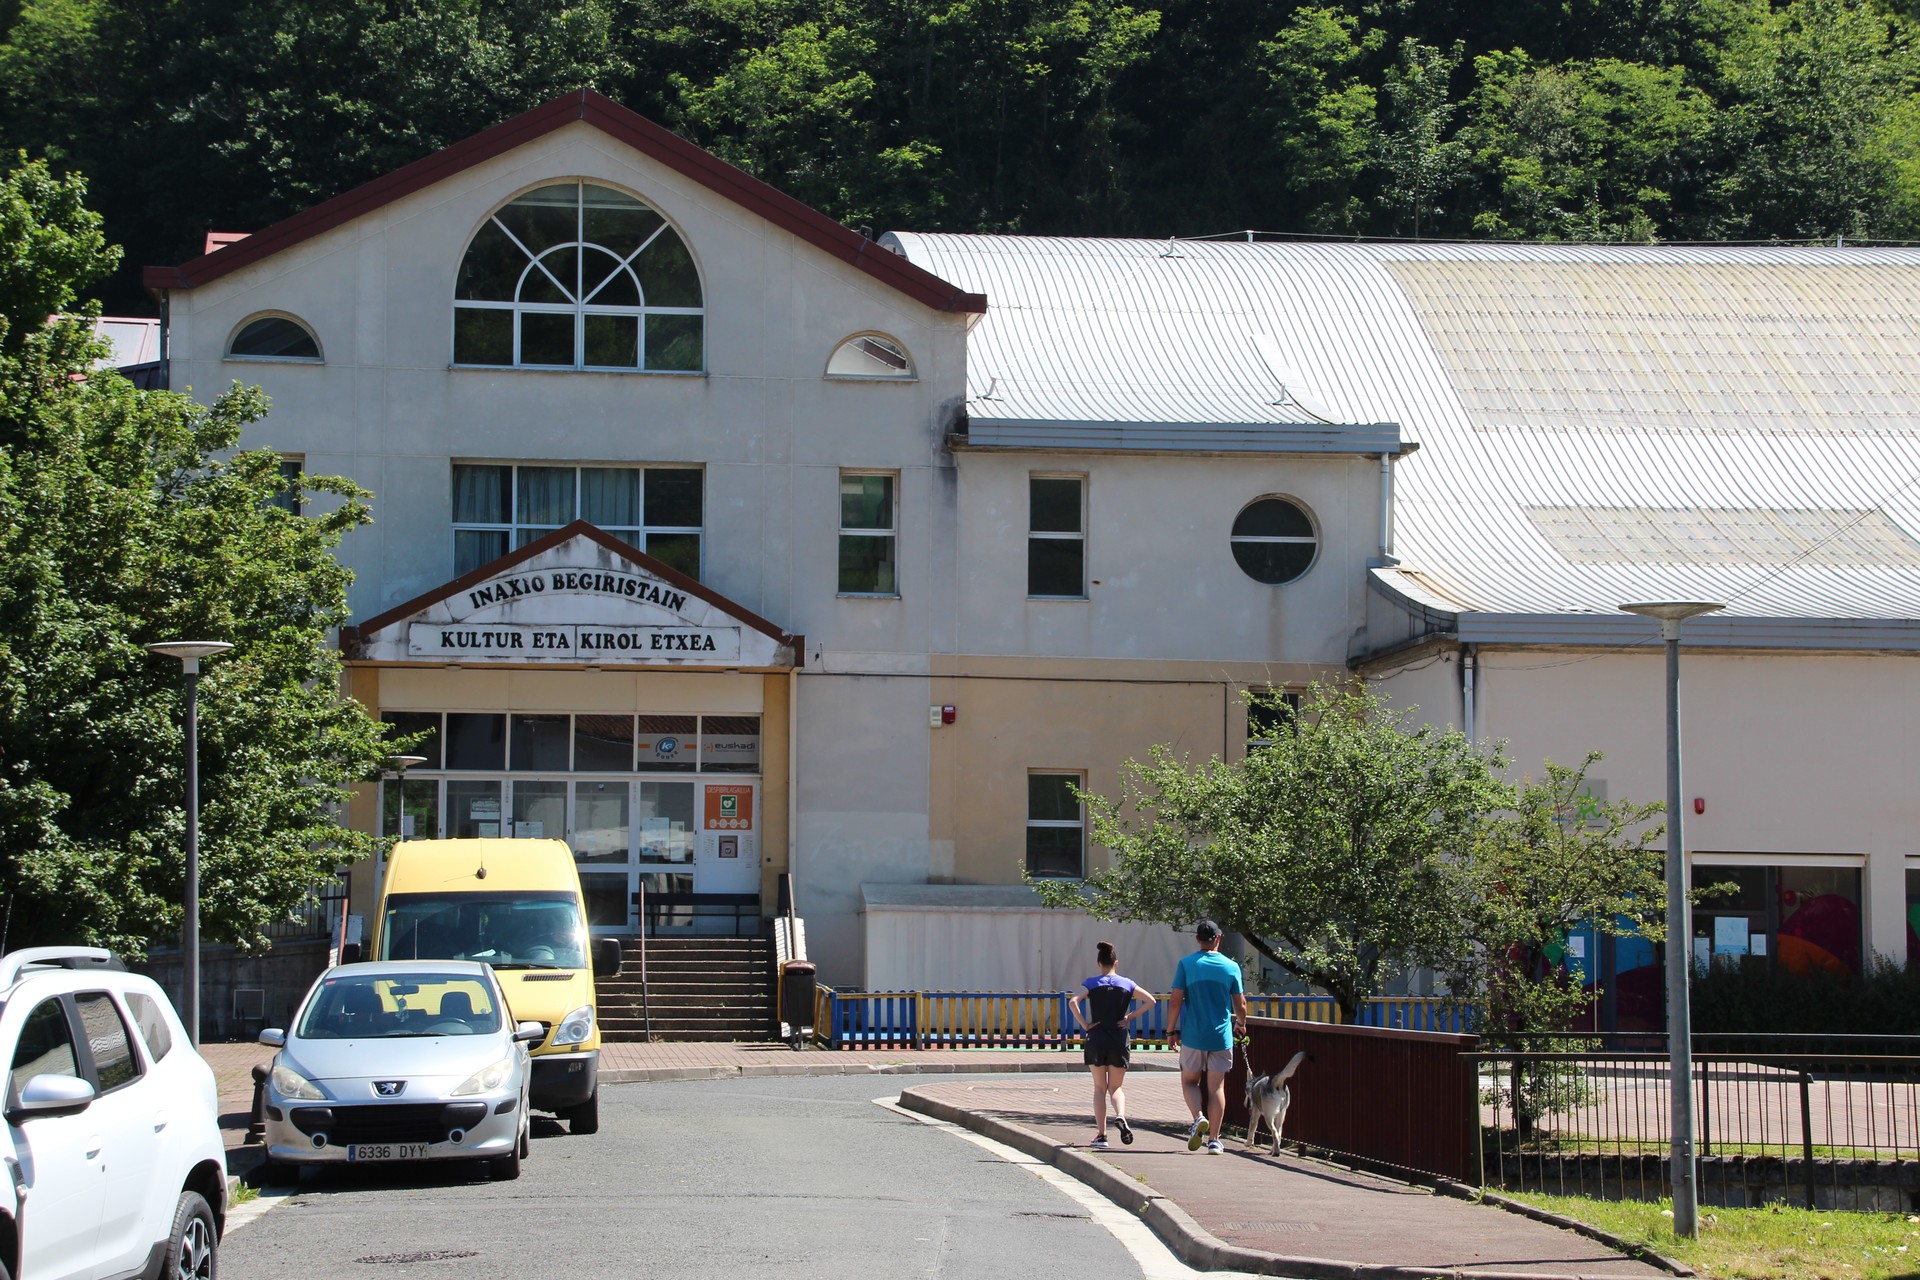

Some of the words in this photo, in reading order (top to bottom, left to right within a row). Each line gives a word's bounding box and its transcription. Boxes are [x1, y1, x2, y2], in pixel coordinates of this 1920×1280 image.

[469, 574, 545, 609] INAXIO
[552, 573, 686, 612] BEGIRISTAIN
[440, 631, 523, 649] KULTUR
[532, 632, 571, 649] ETA
[580, 633, 643, 650] KIROL
[650, 634, 716, 651] ETXEA
[714, 742, 756, 750] euskadi
[358, 1146, 391, 1159] 6336
[399, 1145, 425, 1158] DYY
